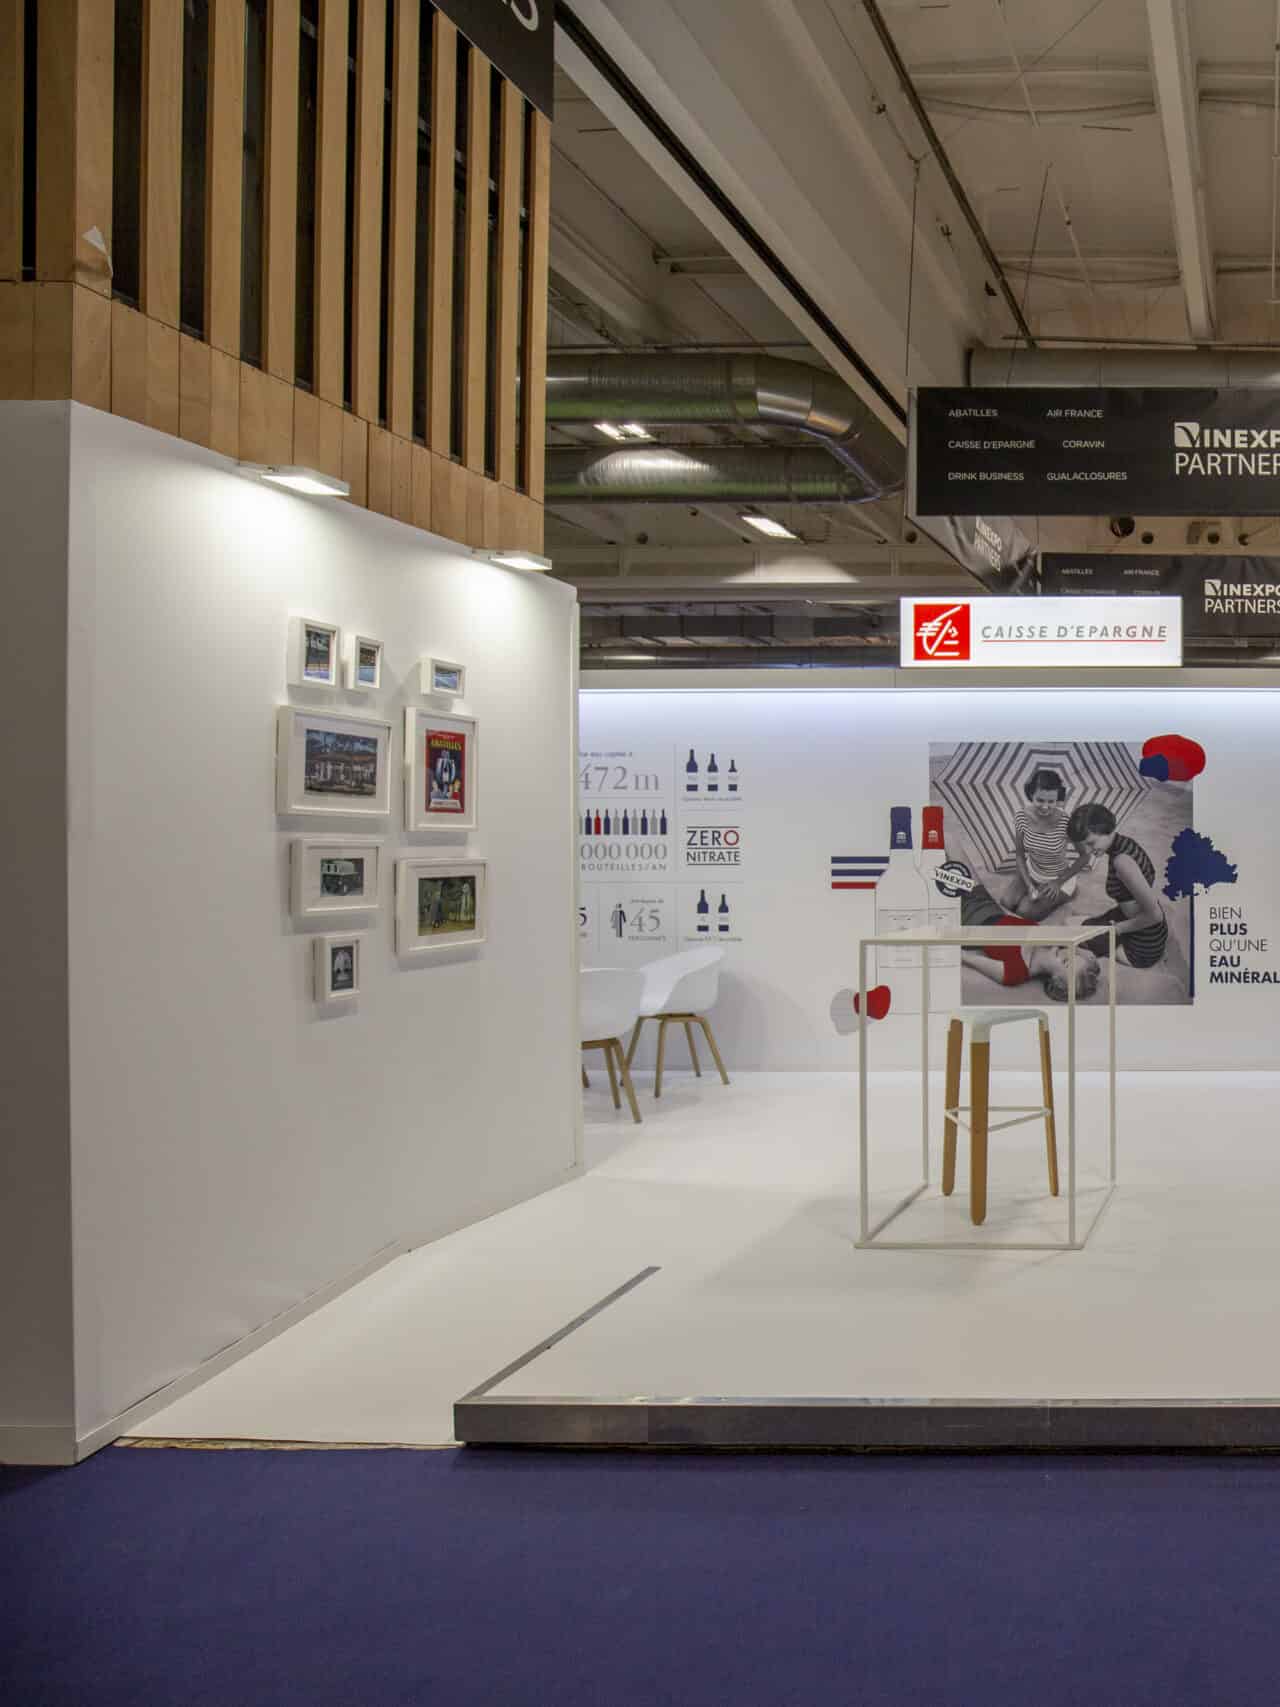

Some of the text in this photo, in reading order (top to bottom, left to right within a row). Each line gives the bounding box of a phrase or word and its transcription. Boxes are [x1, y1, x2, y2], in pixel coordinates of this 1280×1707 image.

[948, 409, 999, 418] ABATILLES
[1046, 409, 1104, 419] AIR FRANCE
[948, 440, 1036, 449] CAISSE D'EPARGNE
[1062, 439, 1105, 449] CORAVIN
[947, 471, 1025, 481] DRINK BUSINESS
[1046, 471, 1128, 481] GUALACLOSURES
[981, 625, 1168, 639] CAISSE D'EPARGNE
[687, 830, 740, 846] ZERO
[687, 851, 740, 862] NITRATE
[630, 906, 660, 932] 45
[1209, 906, 1241, 920] BIEN
[1209, 922, 1248, 936] PLUS
[1209, 939, 1269, 952] QU'UNE
[1209, 955, 1241, 968] EAU
